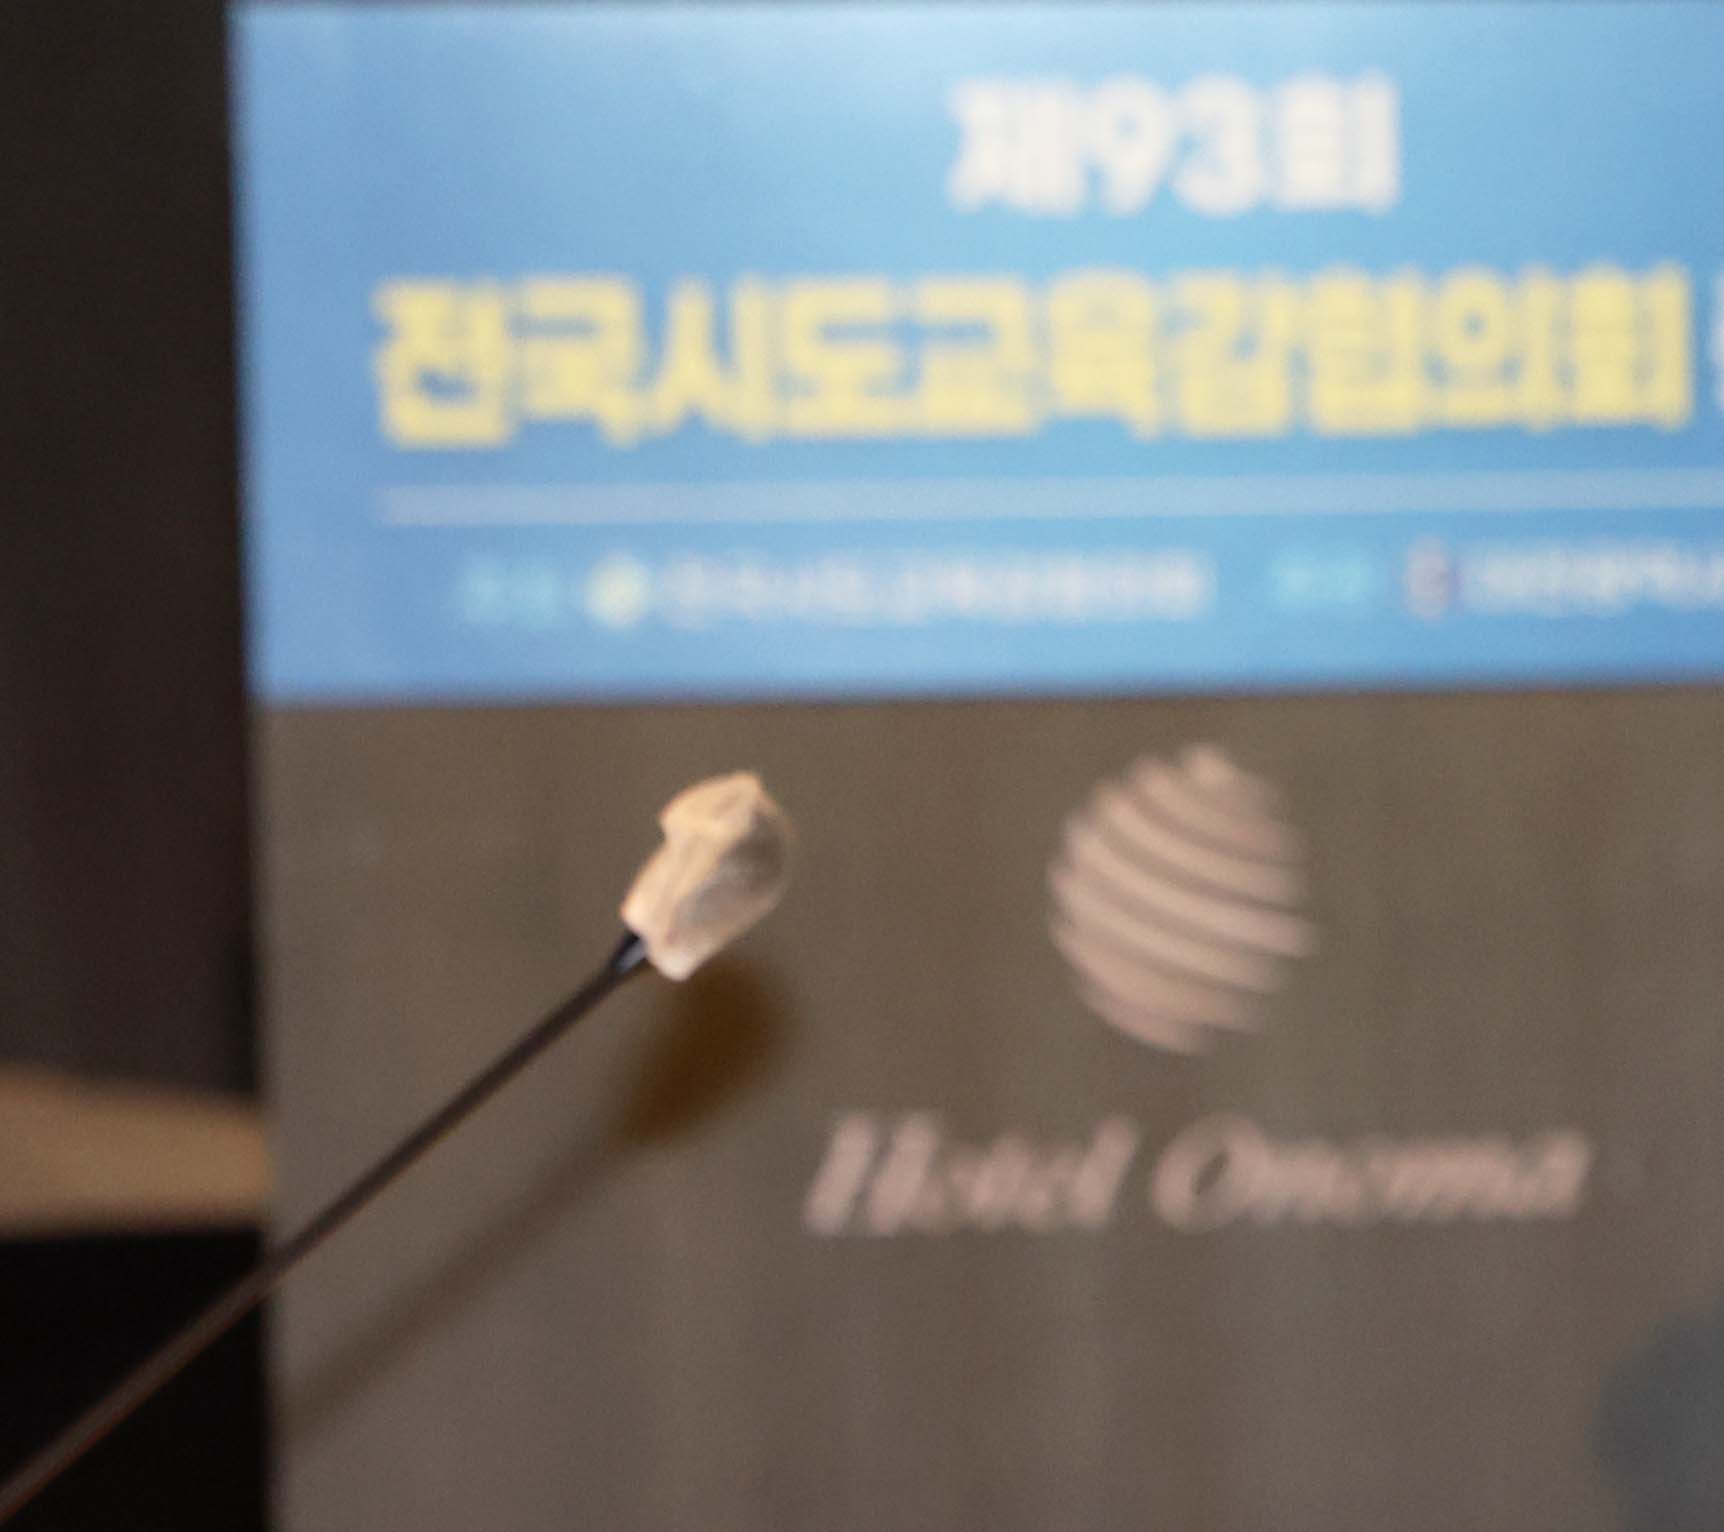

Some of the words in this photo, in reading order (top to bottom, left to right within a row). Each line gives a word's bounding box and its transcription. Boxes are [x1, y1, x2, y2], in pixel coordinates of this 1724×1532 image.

[950, 74, 1399, 214] 제93회
[374, 266, 1690, 443] 전국시도교육감협의회
[805, 1112, 1140, 1234] Hotel
